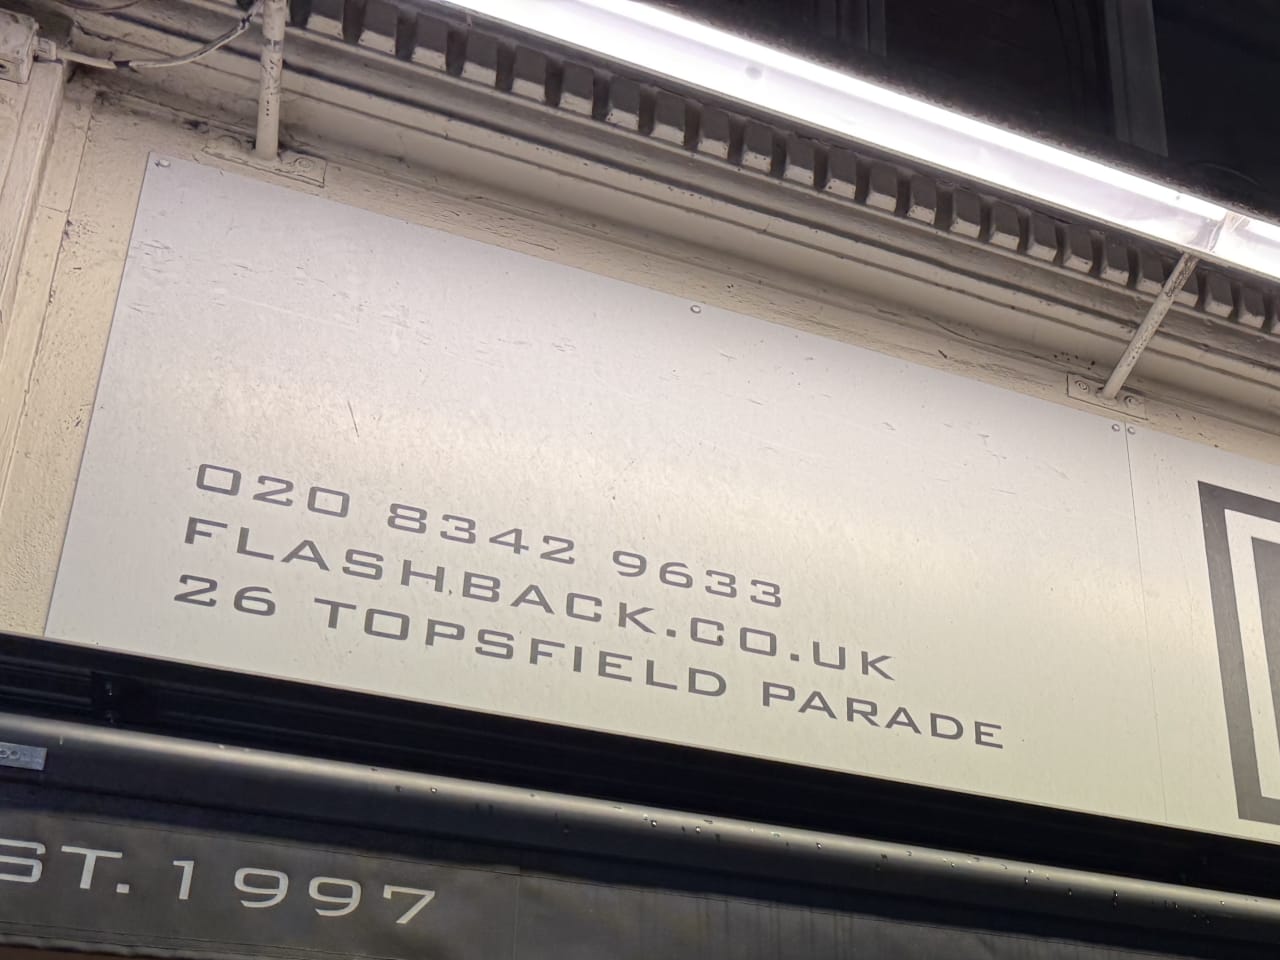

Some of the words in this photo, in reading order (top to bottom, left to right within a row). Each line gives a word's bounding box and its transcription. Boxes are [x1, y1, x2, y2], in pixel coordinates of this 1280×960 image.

[184, 516, 896, 682] FLASHBACK.CO.UK
[196, 463, 350, 519] 020
[387, 503, 576, 565] 8342
[612, 550, 783, 608] 9633
[174, 574, 277, 618] 26
[313, 596, 728, 698] TOPSFIELD
[762, 681, 1005, 750] PARADE
[0, 838, 130, 894] ST.
[172, 860, 436, 925] 1997
